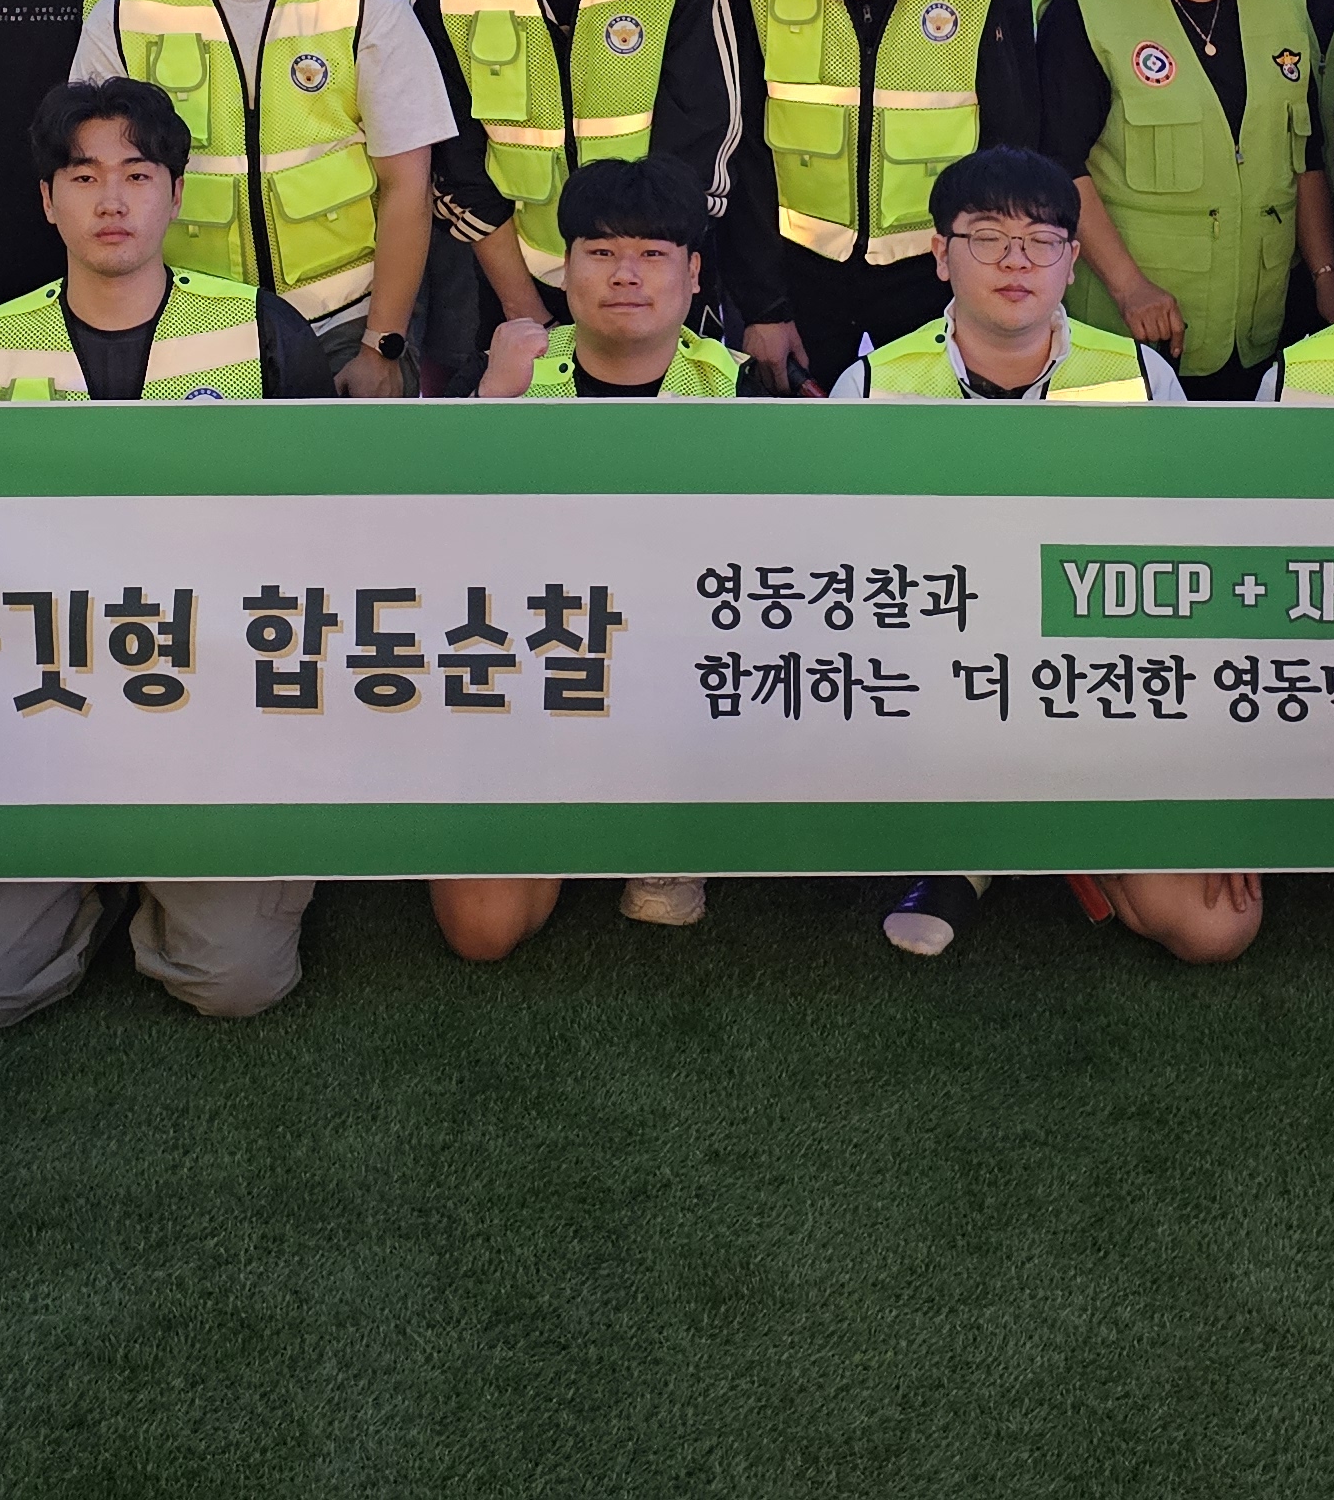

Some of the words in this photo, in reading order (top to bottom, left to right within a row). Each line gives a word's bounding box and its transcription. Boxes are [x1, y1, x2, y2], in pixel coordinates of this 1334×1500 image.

[696, 562, 979, 633] 영동경찰과
[1063, 562, 1211, 617] YDCP
[1234, 574, 1267, 606] +
[242, 583, 628, 716] 합동순찰
[694, 651, 920, 722] 함께하는
[951, 652, 1009, 722] '더
[1031, 653, 1197, 720] 안전한
